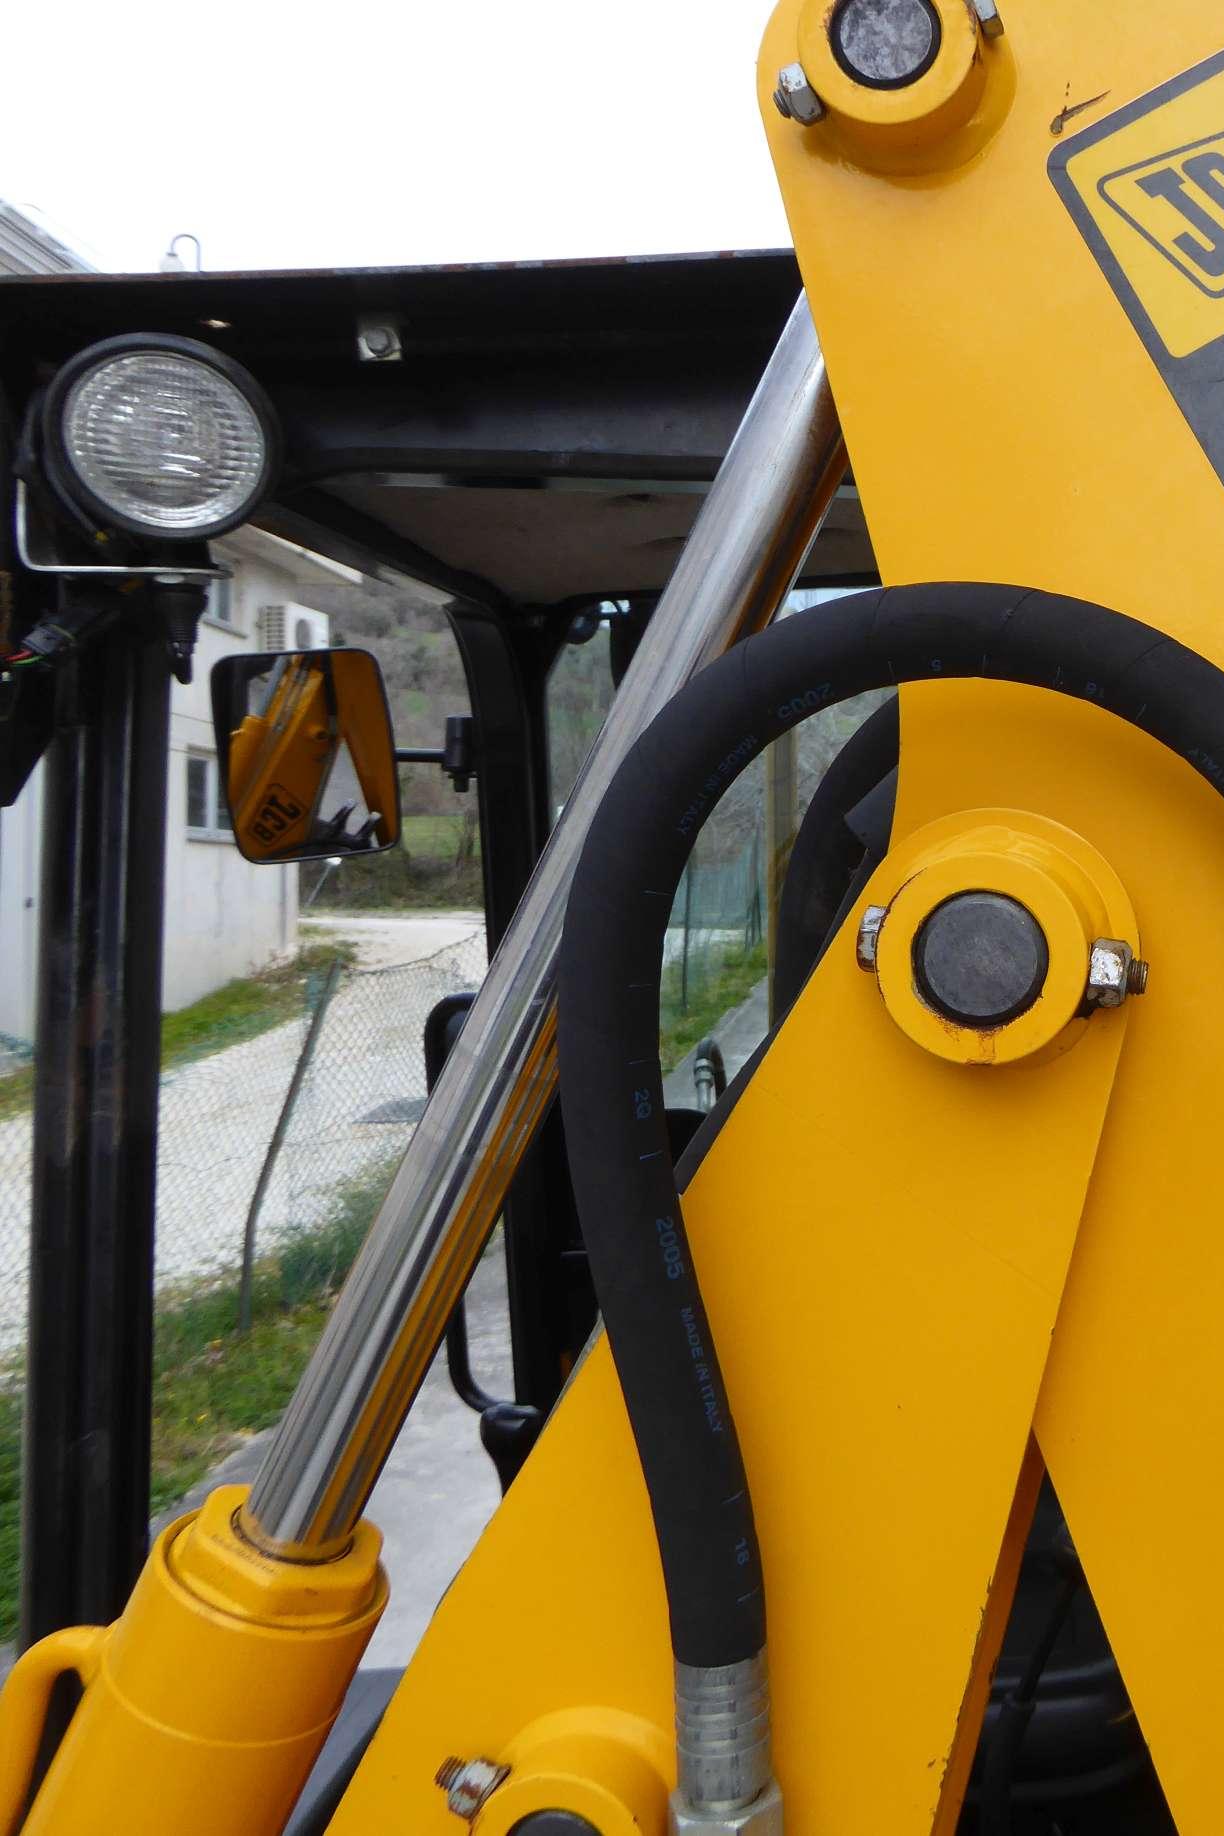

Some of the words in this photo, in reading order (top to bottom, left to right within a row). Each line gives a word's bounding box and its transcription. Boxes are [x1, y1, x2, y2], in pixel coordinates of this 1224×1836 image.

[656, 1215, 685, 1280] 2005
[680, 1304, 704, 1360] MADE
[701, 1382, 724, 1433] ITALY
